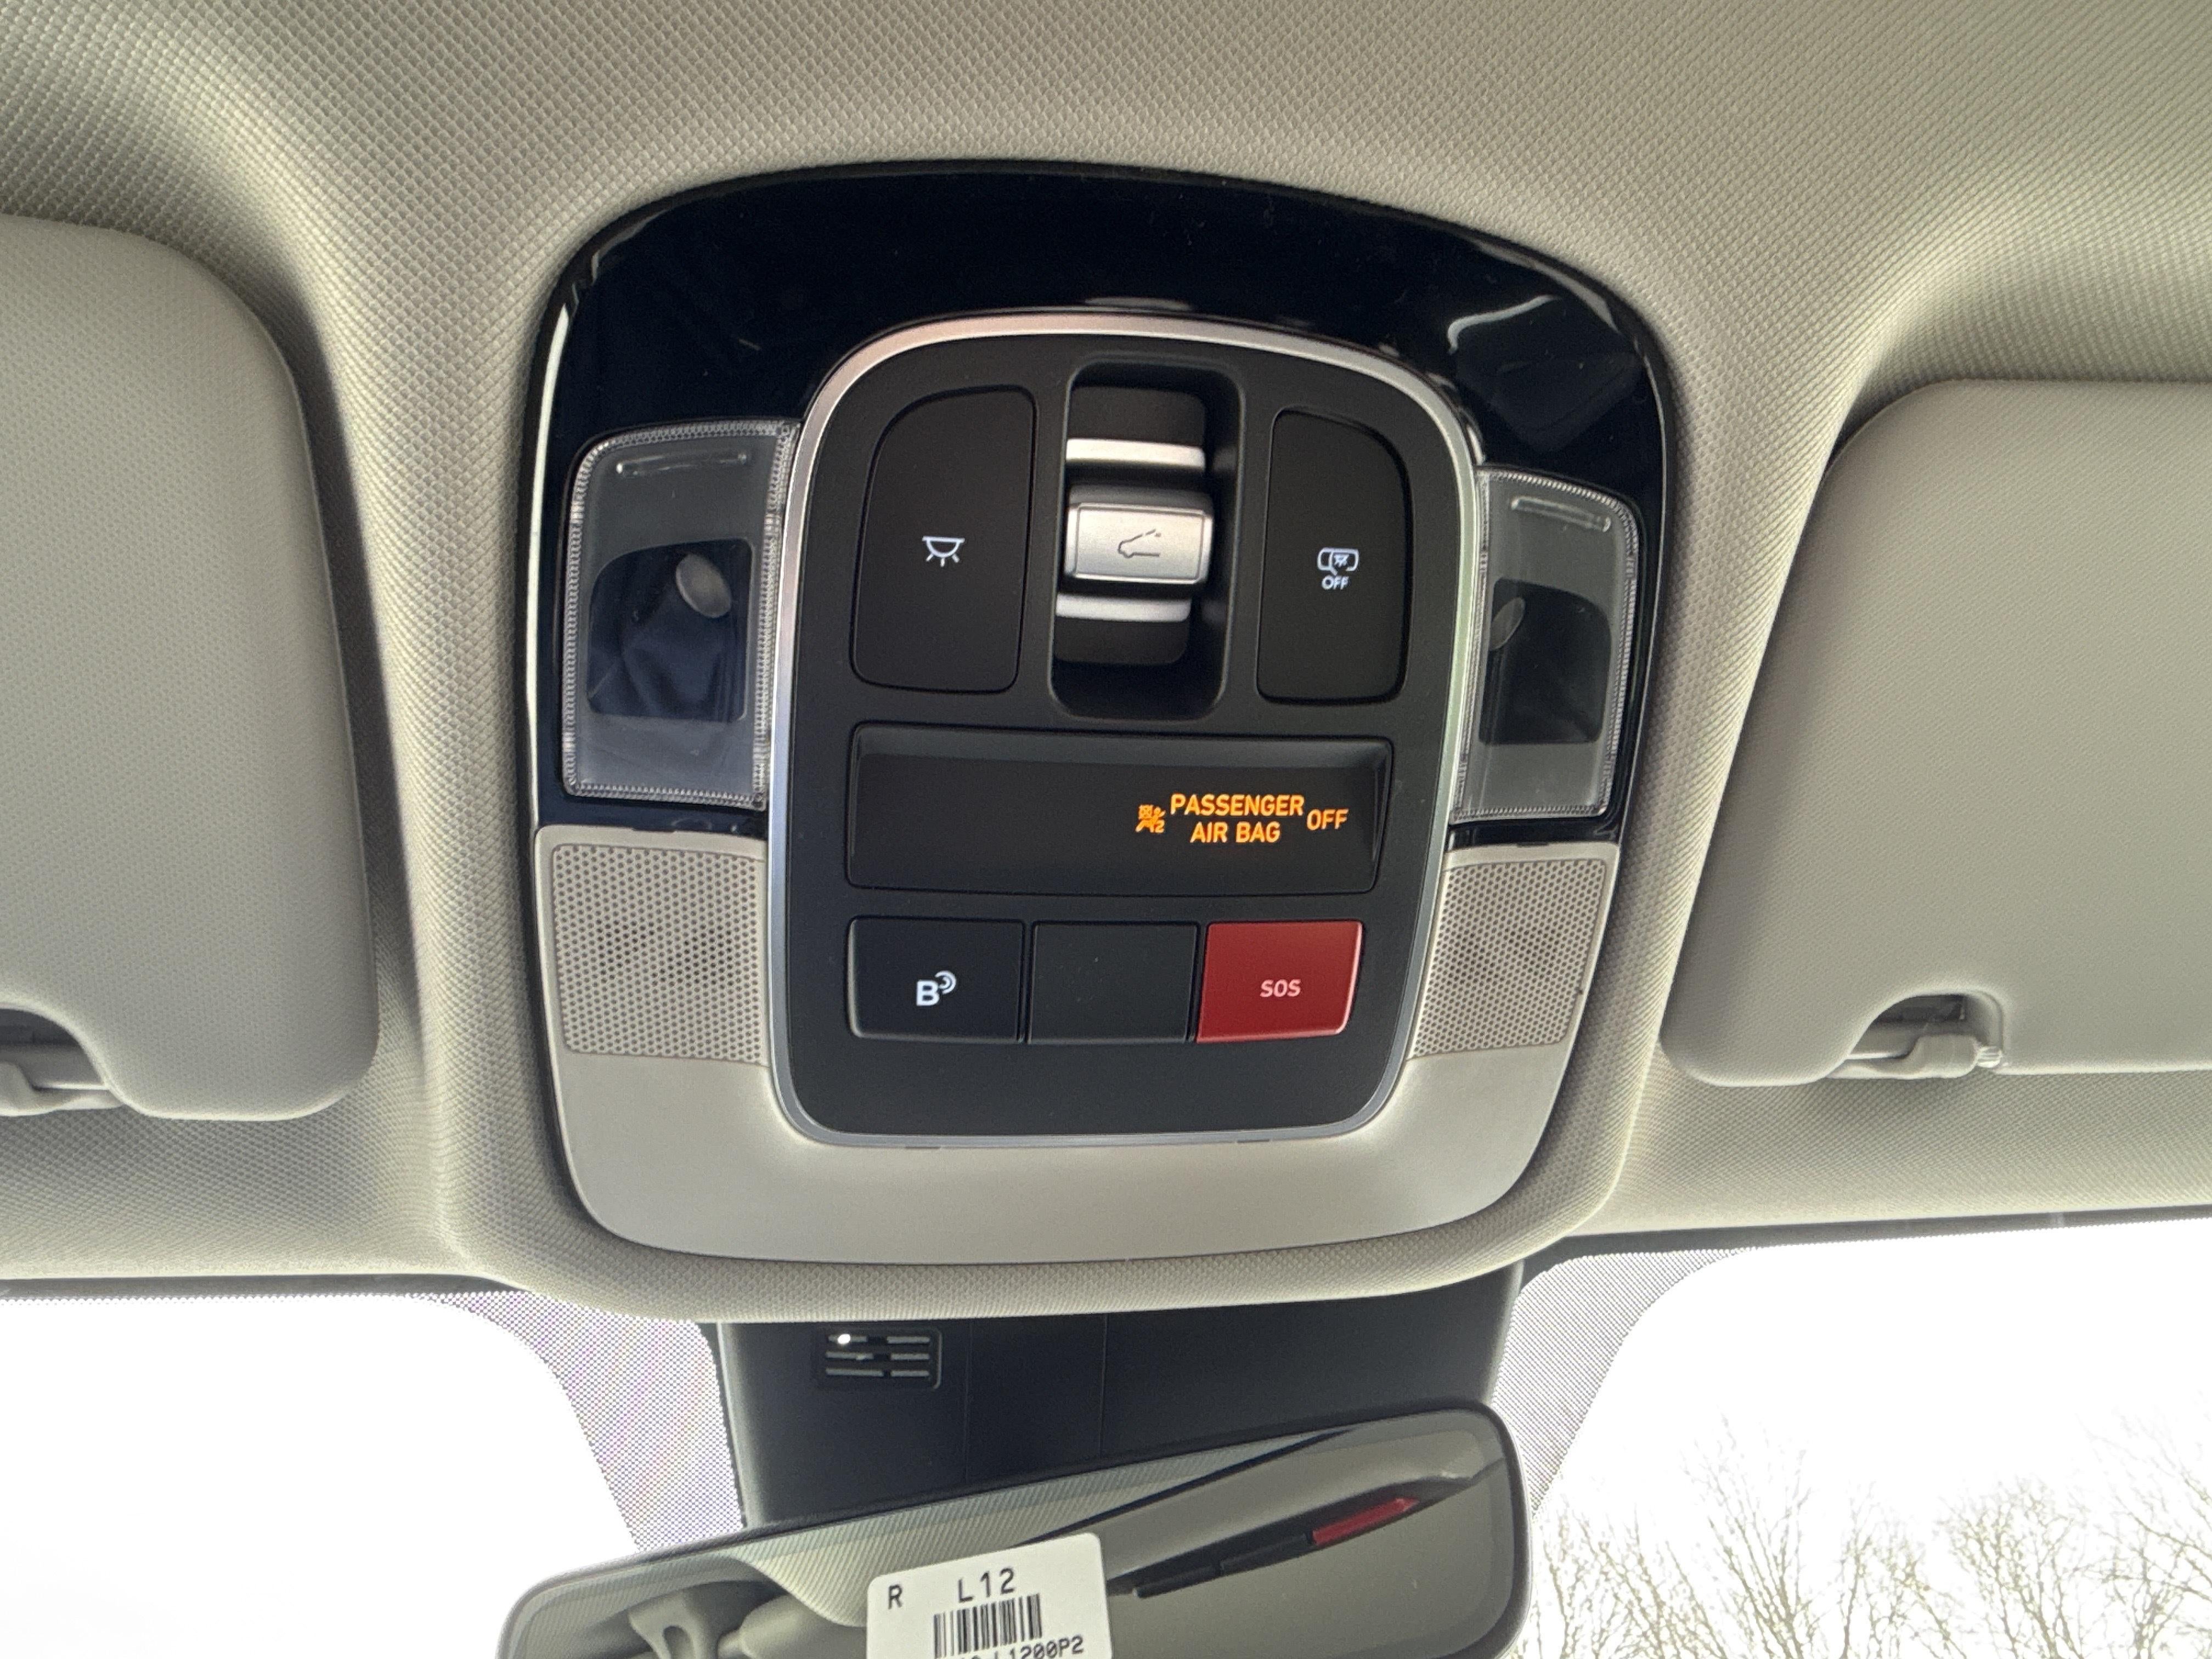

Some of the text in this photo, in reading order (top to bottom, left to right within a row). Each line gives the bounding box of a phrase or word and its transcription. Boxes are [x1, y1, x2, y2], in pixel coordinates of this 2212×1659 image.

[1321, 575, 1350, 590] OFF
[1170, 793, 1305, 816] PASSENGER
[1307, 809, 1348, 831] OFF
[1190, 821, 1280, 843] AIR BAG
[1260, 979, 1301, 997] SOS
[958, 1567, 1015, 1603] L12
[888, 1584, 903, 1610] R
